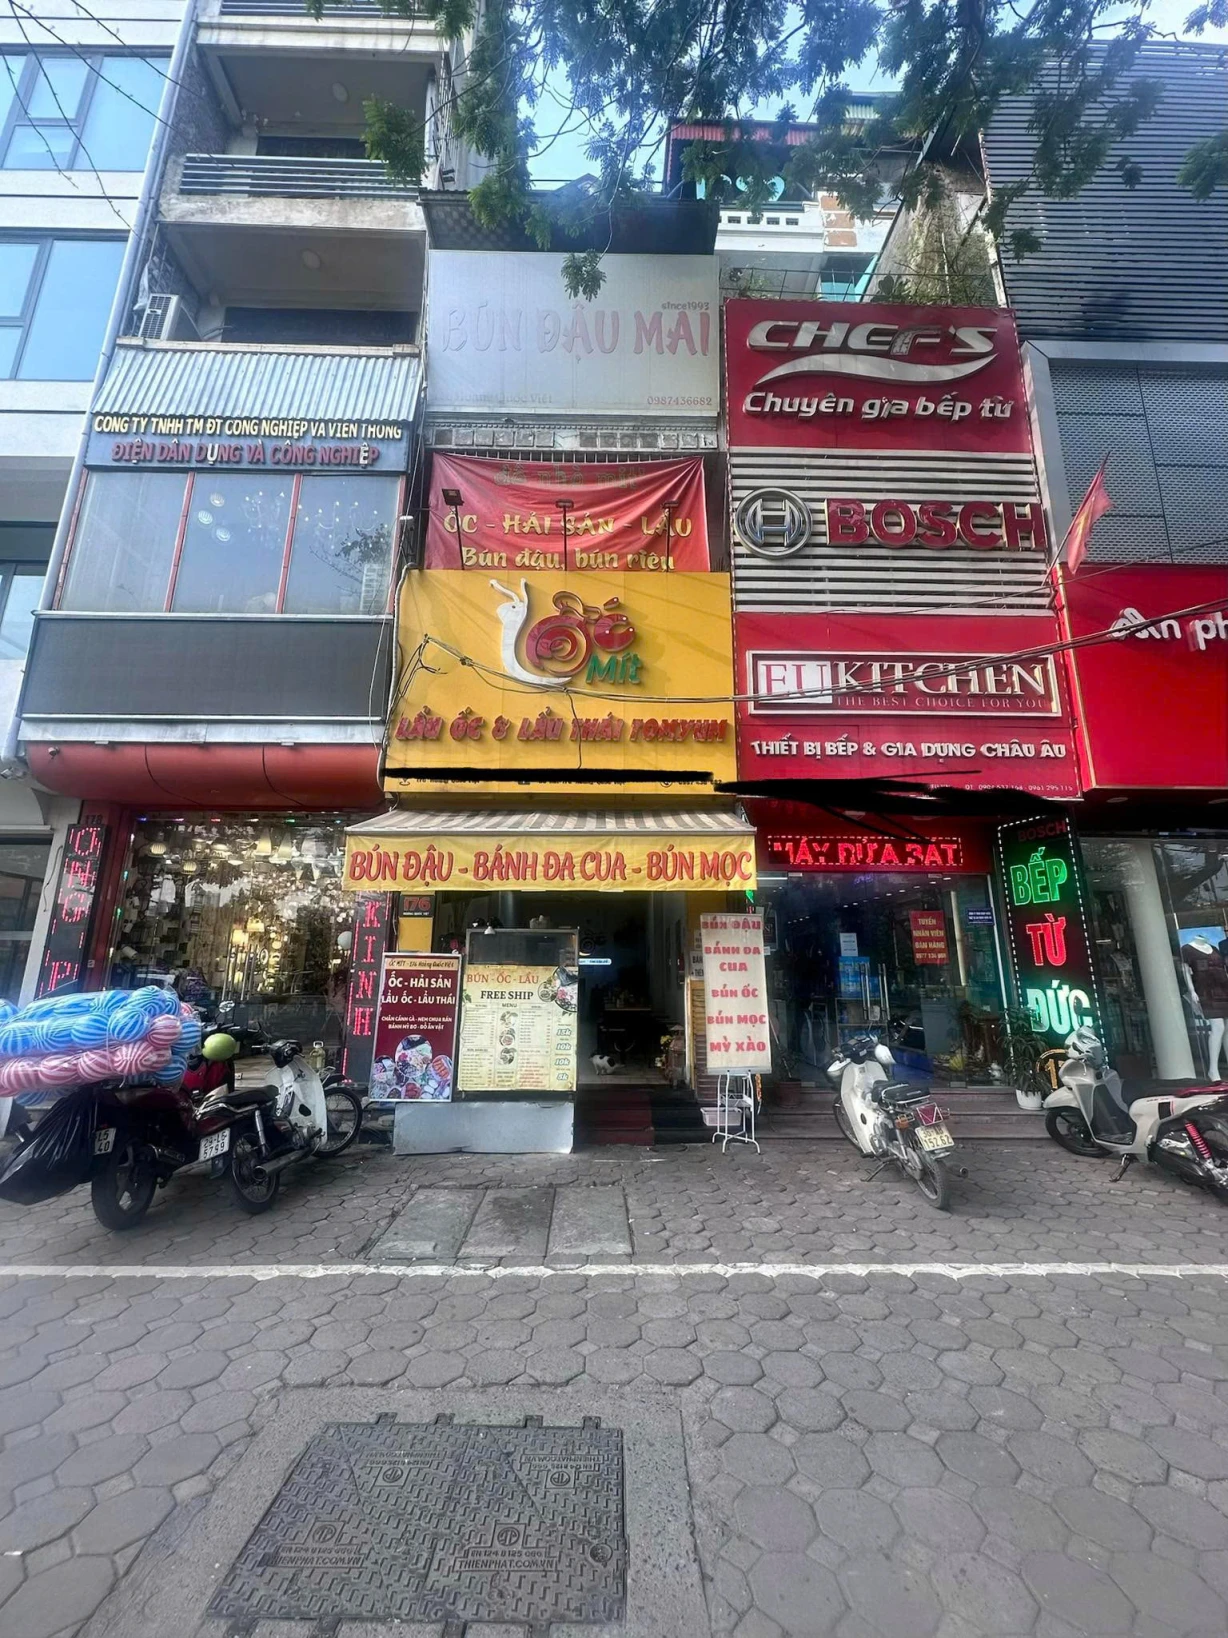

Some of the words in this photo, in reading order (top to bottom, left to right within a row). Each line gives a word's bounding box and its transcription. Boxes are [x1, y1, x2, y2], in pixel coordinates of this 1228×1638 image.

[442, 302, 522, 353] BÚN
[536, 303, 620, 364] ĐẬU
[633, 310, 711, 356] MAI
[747, 320, 998, 355] CHEF'S
[744, 392, 854, 418] Chuyên
[862, 396, 909, 420] gia
[915, 392, 972, 421] bếp
[980, 396, 1014, 419] từ
[132, 417, 149, 434] TY
[151, 418, 183, 435] TNHH
[186, 418, 203, 435] TM
[206, 419, 223, 435] ĐT
[112, 438, 154, 464] ĐIỆN
[157, 438, 193, 463] DÂN
[195, 443, 242, 466] DỤNG
[246, 439, 265, 465] VÀ
[270, 440, 315, 466] CÔNG
[319, 442, 380, 469] NGHIỆP
[443, 507, 477, 533] ỐC
[503, 512, 550, 535] HẢI
[561, 511, 615, 536] SẢN
[825, 498, 1048, 551] BOSCH
[461, 546, 507, 567] Bún
[574, 543, 619, 569] bún
[585, 651, 643, 684] Mít
[836, 696, 866, 706] THE
[873, 697, 907, 707] BEST
[915, 697, 975, 708] CHOICE
[982, 698, 1010, 708] FOR
[450, 706, 484, 741] ỐC
[517, 706, 564, 741] LẨU
[570, 711, 624, 742] THÁI
[629, 718, 728, 742] TOMYUM
[751, 733, 799, 756] THIẾT
[803, 741, 821, 759] BỊ
[825, 733, 858, 756] BẾP
[863, 741, 877, 756] &
[880, 742, 917, 757] GIA
[921, 742, 976, 764] DỤNG
[980, 739, 1036, 758] CHÂU
[1040, 739, 1067, 758] ÂU
[1018, 819, 1067, 841] BOSCH
[349, 843, 400, 882] BÚN
[402, 843, 454, 887] ĐẬU
[473, 843, 539, 882] BÁNH
[541, 850, 576, 882] ĐA
[580, 850, 627, 882] CUA
[646, 843, 695, 882] BÚN
[700, 850, 752, 887] MỌC
[1010, 846, 1068, 906] BẾP
[403, 896, 431, 912] 176
[701, 915, 728, 930] BÚN
[731, 917, 762, 933] ĐẬU
[704, 941, 741, 955] BÁNH
[743, 945, 762, 955] ĐA
[1026, 913, 1067, 967] TỪ
[388, 970, 403, 988] ỐC
[410, 974, 428, 988] HẢI
[430, 974, 452, 988] SẢN
[466, 972, 489, 983] BÚN
[496, 971, 512, 984] ỐC
[518, 971, 539, 984] LẨU
[719, 961, 749, 972] CUA
[381, 990, 399, 1004] LẨU
[401, 990, 413, 1004] ỐC
[418, 990, 435, 1004] LẨU
[436, 993, 455, 1005] THÁI
[711, 984, 738, 999] BÚN
[741, 984, 759, 998] ỐC
[707, 1010, 734, 1025] BÚN
[737, 1014, 767, 1027] MỌC
[1025, 980, 1094, 1035] ĐỨC
[735, 1036, 767, 1053] XÀO
